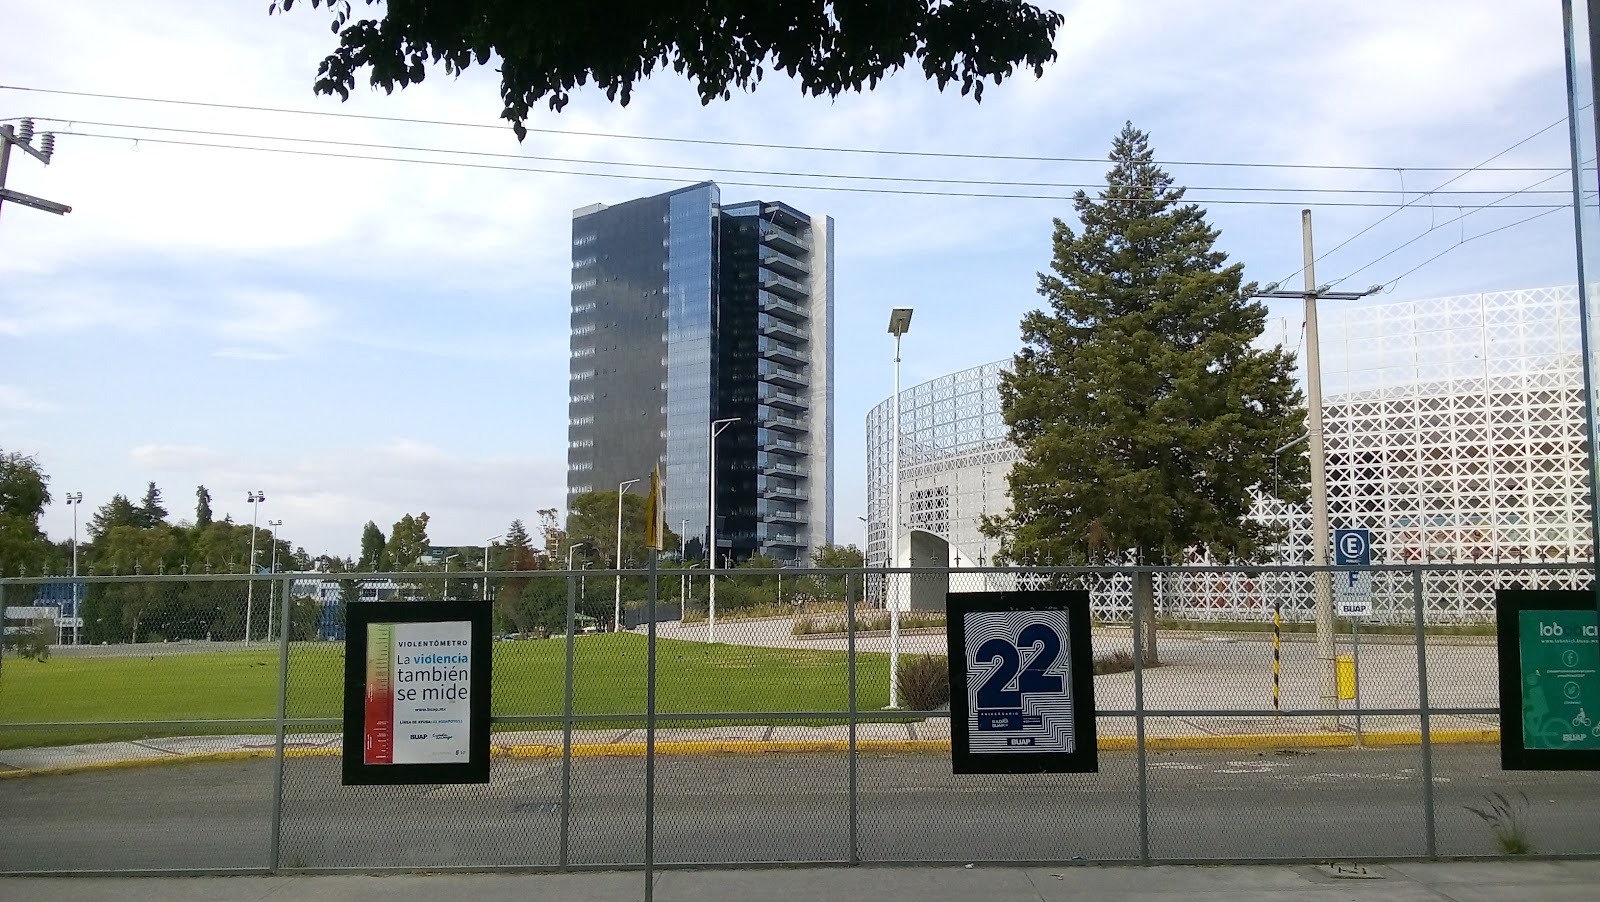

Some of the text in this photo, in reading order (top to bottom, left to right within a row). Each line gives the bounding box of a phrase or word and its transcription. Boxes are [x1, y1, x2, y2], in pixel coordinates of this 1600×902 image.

[1347, 538, 1358, 553] E
[1348, 571, 1359, 587] F
[398, 639, 468, 648] VIOLENTÓMETRO
[397, 653, 468, 665] La violencia
[976, 623, 1063, 708] 22
[397, 665, 468, 682] también
[397, 683, 468, 701] se mide
[1562, 733, 1587, 741] BUAP
